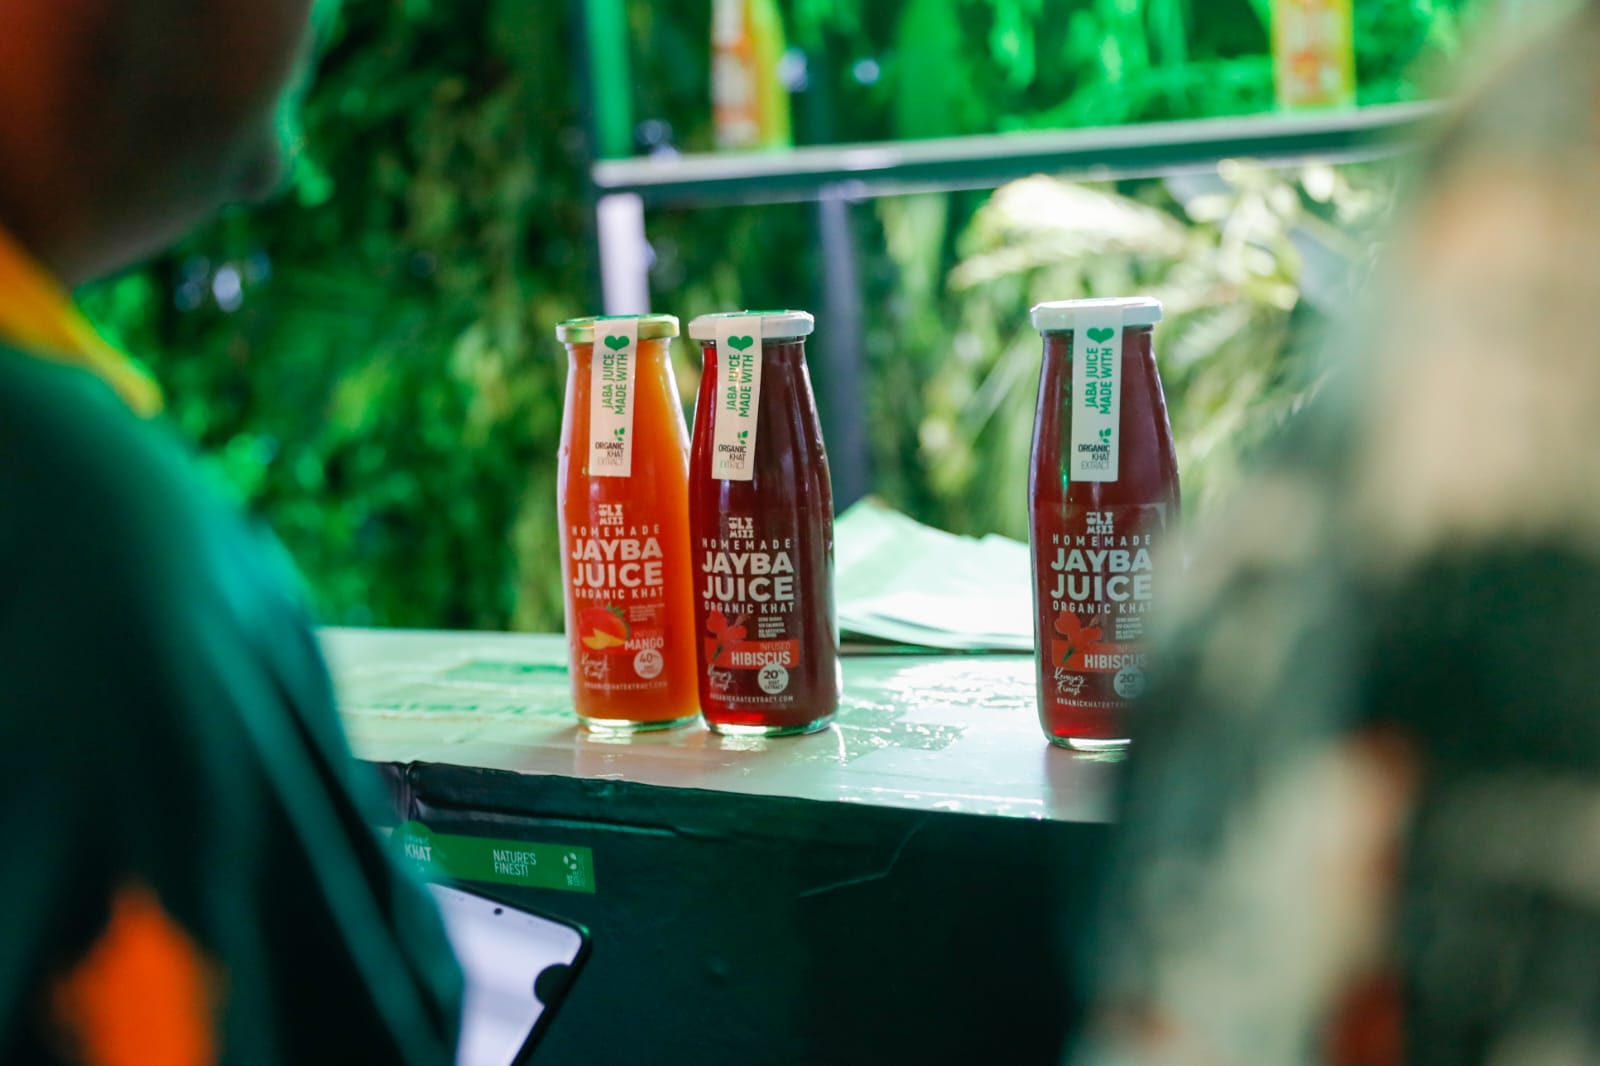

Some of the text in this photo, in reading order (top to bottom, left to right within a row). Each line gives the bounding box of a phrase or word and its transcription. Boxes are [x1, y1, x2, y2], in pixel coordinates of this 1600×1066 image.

[602, 354, 615, 409] JABA JUICE
[614, 354, 628, 415] MADE WITH
[1085, 347, 1100, 408] JABA JUICE
[1099, 348, 1113, 414] MADE WITH
[738, 354, 754, 417] MADE WITH
[726, 386, 738, 412] JABA
[595, 441, 624, 450] ORGANIC
[718, 444, 747, 453] ORGANIC
[1078, 444, 1110, 453] ORGANIC
[607, 450, 624, 458] KHAT
[729, 453, 746, 461] KHAT
[1092, 452, 1110, 461] KHAT
[572, 524, 660, 537] HOMEMADE
[702, 538, 791, 550] HOMEMADE
[1052, 533, 1151, 547] HOMEMADE
[572, 537, 663, 561] JAYBA
[702, 551, 794, 575] JAYBA
[1050, 547, 1153, 573] JAYBA
[573, 561, 664, 588] JUICE
[575, 586, 664, 600] ORGANIC KHAT
[702, 576, 794, 602] JUICE
[1050, 574, 1153, 601] JUICE
[704, 600, 794, 614] ORGANIC KHAT
[1053, 600, 1111, 614] ORGANIC
[624, 637, 664, 650] MANGO
[731, 651, 791, 666] HIBISCUS
[405, 843, 432, 862] KHAT
[493, 849, 537, 866] NATURE'S
[494, 862, 529, 877] FINEST!
